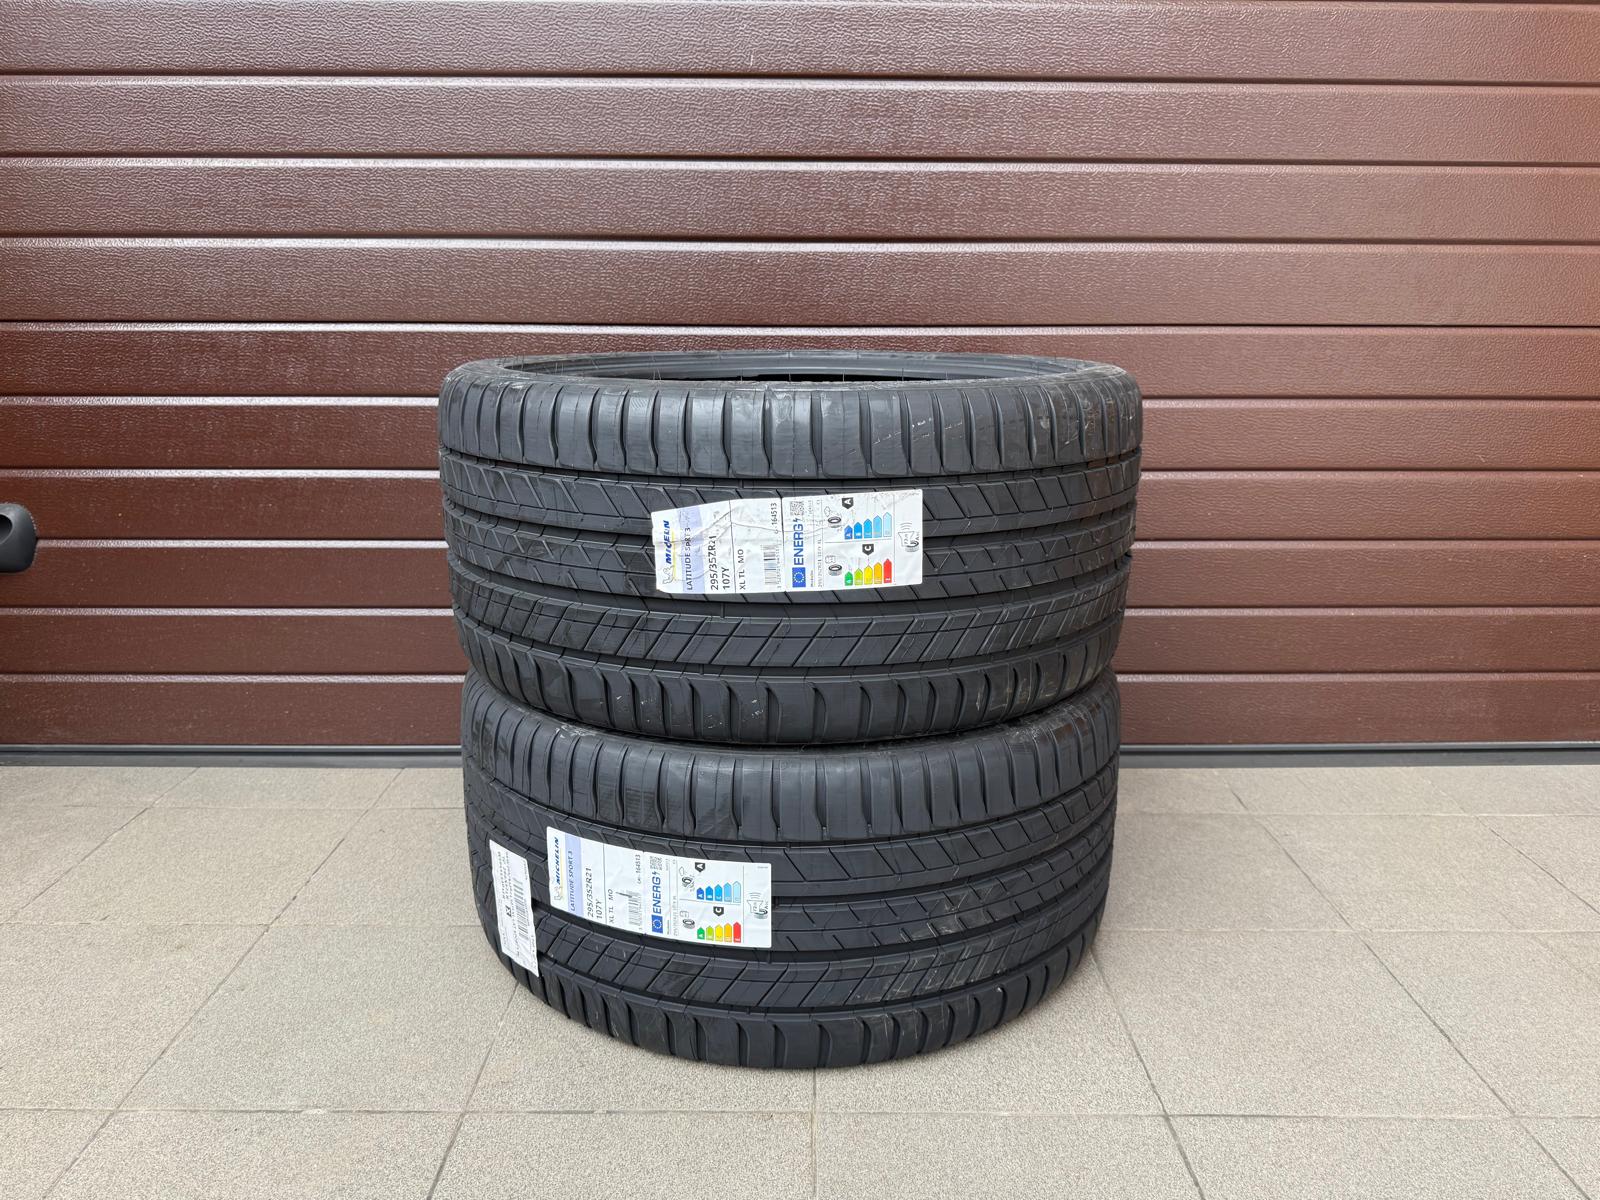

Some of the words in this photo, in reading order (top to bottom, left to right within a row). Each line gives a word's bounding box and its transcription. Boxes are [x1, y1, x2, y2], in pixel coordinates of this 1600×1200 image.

[738, 549, 744, 564] MO
[708, 535, 718, 590] 295/35ZR21
[721, 567, 730, 590] 107Y
[739, 570, 745, 579] TL
[739, 581, 746, 590] XL
[586, 867, 594, 918] 295/35ZR21
[608, 889, 614, 900] MO
[609, 906, 614, 914] TL
[609, 915, 615, 924] XL
